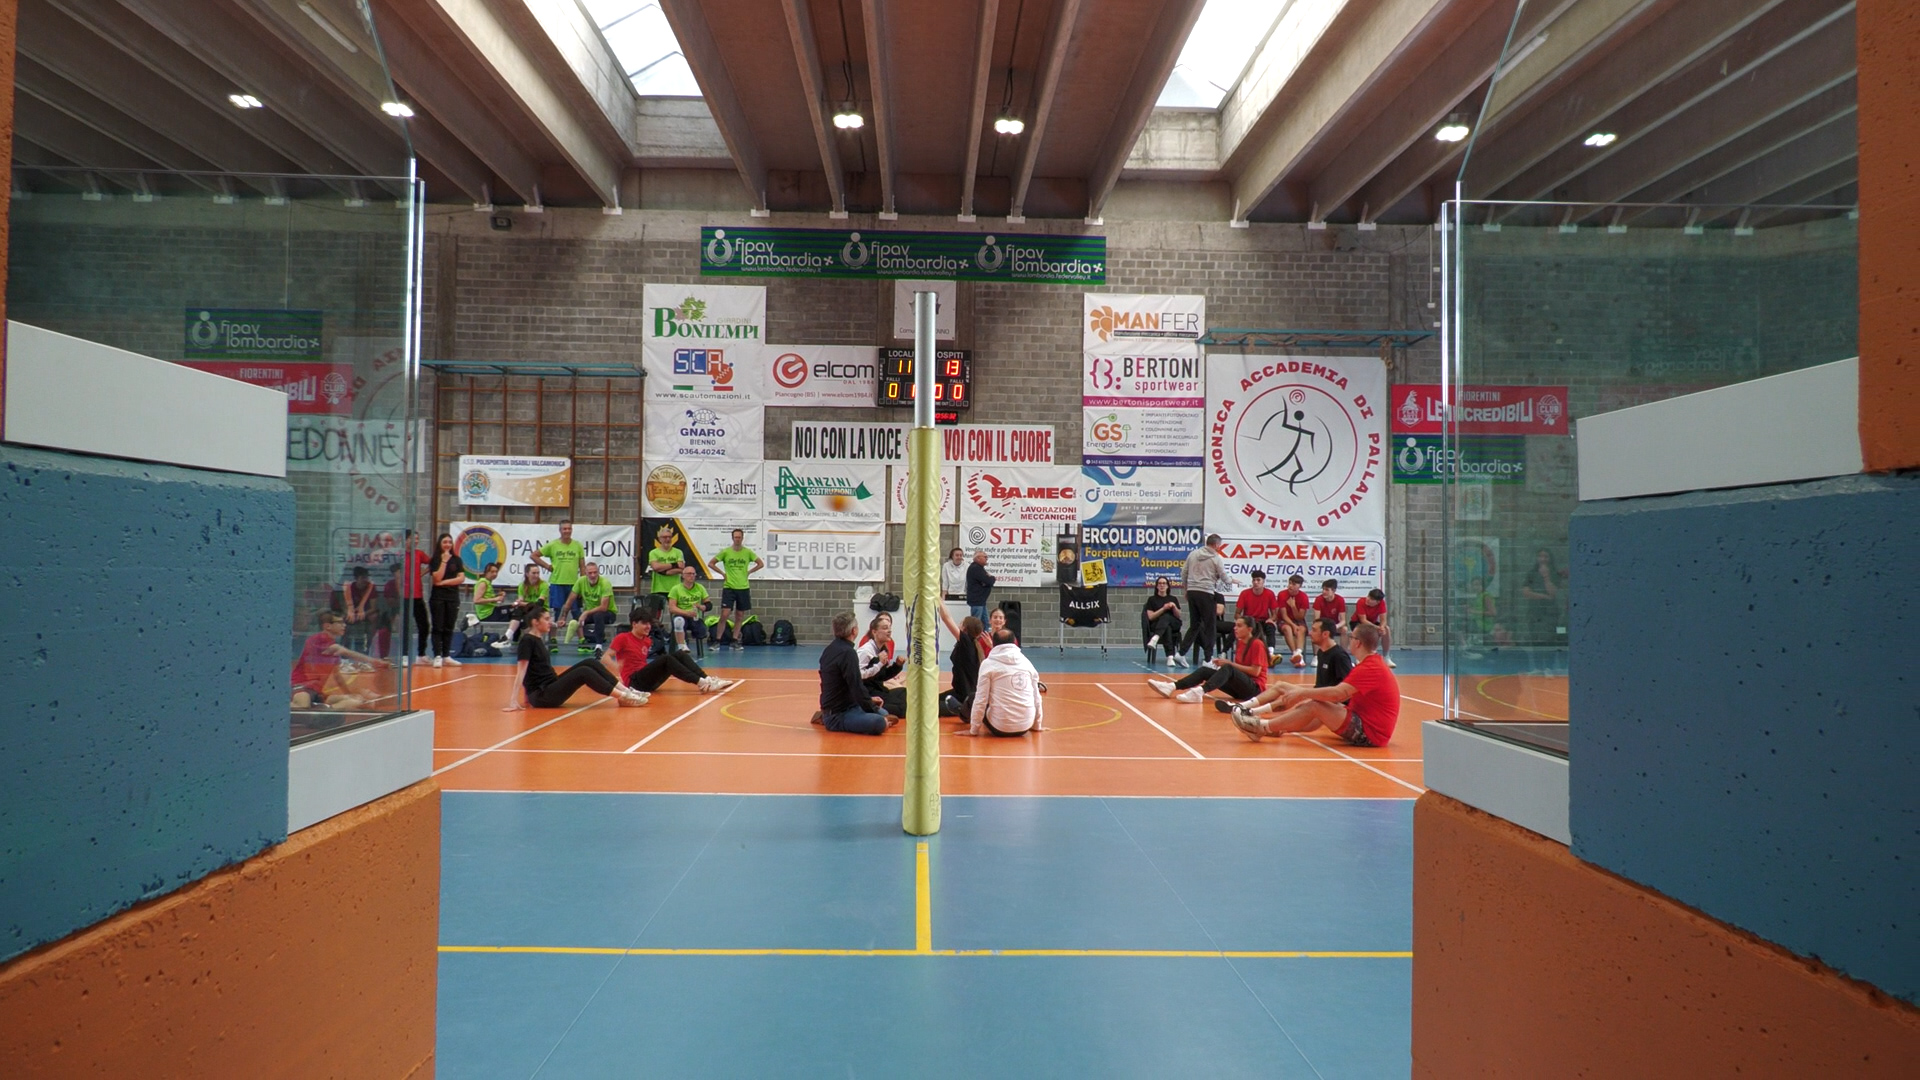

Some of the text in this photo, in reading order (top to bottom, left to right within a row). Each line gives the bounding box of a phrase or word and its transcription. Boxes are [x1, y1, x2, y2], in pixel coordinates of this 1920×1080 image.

[735, 238, 774, 255] fipav
[871, 241, 910, 258] fipav
[1005, 244, 1045, 261] fipav
[741, 252, 822, 267] lombardia
[877, 255, 957, 270] lombardia
[1011, 259, 1092, 274] lombardia
[649, 307, 760, 339] BONTEMPI
[1113, 312, 1199, 331] MANFER
[226, 335, 308, 350] lombardia
[675, 350, 722, 373] SCA
[888, 350, 915, 358] LOCALI
[240, 368, 284, 379] FIORENTINI
[813, 361, 874, 379] elcom
[898, 360, 912, 374] 11
[946, 360, 960, 376] 13
[1123, 357, 1199, 379] BERTONI
[1239, 361, 1349, 392] ACCADEMIA
[888, 382, 898, 398] 0
[953, 384, 963, 400] 0
[1134, 380, 1199, 394] sportwear
[655, 392, 751, 400] www.scautomazioni.it
[1088, 398, 1199, 407] www.bertonisportwear.it
[1353, 394, 1374, 419] DI
[1539, 402, 1559, 413] CLUB
[680, 428, 725, 437] GNARO
[1093, 423, 1123, 441] GS
[679, 448, 726, 456] 0364.40242
[795, 426, 1052, 462] NOI CON LA VOCE VOI CON IL CUORE
[1086, 441, 1136, 449] Energia Solare
[1211, 399, 1237, 498] CAMONICA
[692, 477, 710, 495] La
[713, 477, 757, 495] Nostra
[1316, 432, 1380, 527] PALLAVOLO
[806, 487, 853, 495] COSTRUZIONI
[991, 487, 1074, 499] BA.MEC
[1103, 489, 1132, 498] Ortensi
[1139, 489, 1161, 498] Dessi
[1167, 490, 1193, 498] Fiorini
[1241, 502, 1304, 532] VALLE
[989, 527, 1034, 545] STF
[1082, 527, 1201, 545] ERCOLI BONOMO
[511, 539, 631, 558] PANHLON
[1085, 547, 1139, 559] Forgiatura
[1216, 543, 1366, 561] KAPPAEMME
[766, 555, 880, 571] BELLICINI
[1141, 557, 1185, 569] Stampag
[1225, 563, 1377, 576] EGNALETICA STRADALE
[1069, 600, 1100, 610] ALLSIX
